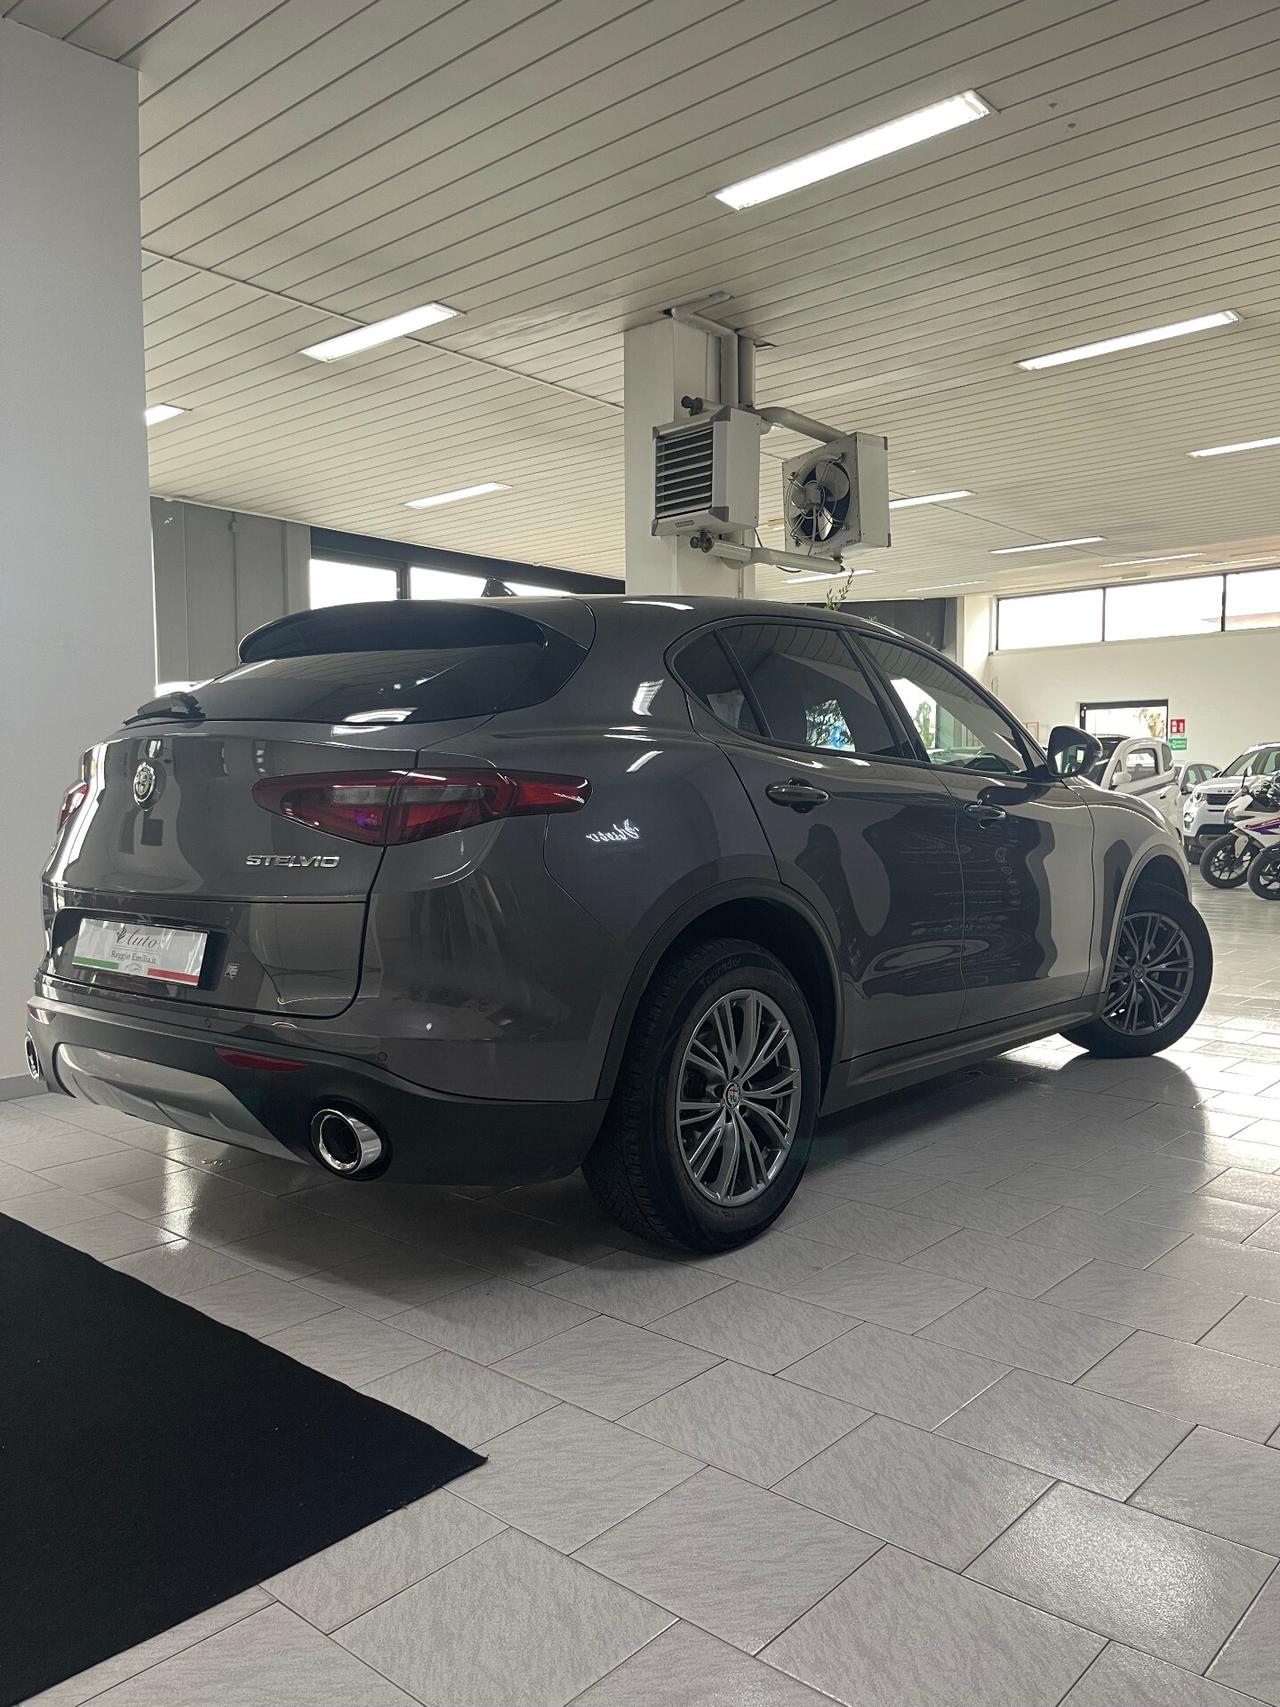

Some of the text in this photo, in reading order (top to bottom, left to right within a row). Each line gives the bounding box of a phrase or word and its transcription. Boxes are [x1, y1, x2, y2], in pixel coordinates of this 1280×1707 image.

[246, 854, 340, 868] STELVIO
[116, 927, 159, 948] Auto
[111, 949, 131, 962] Reggio
